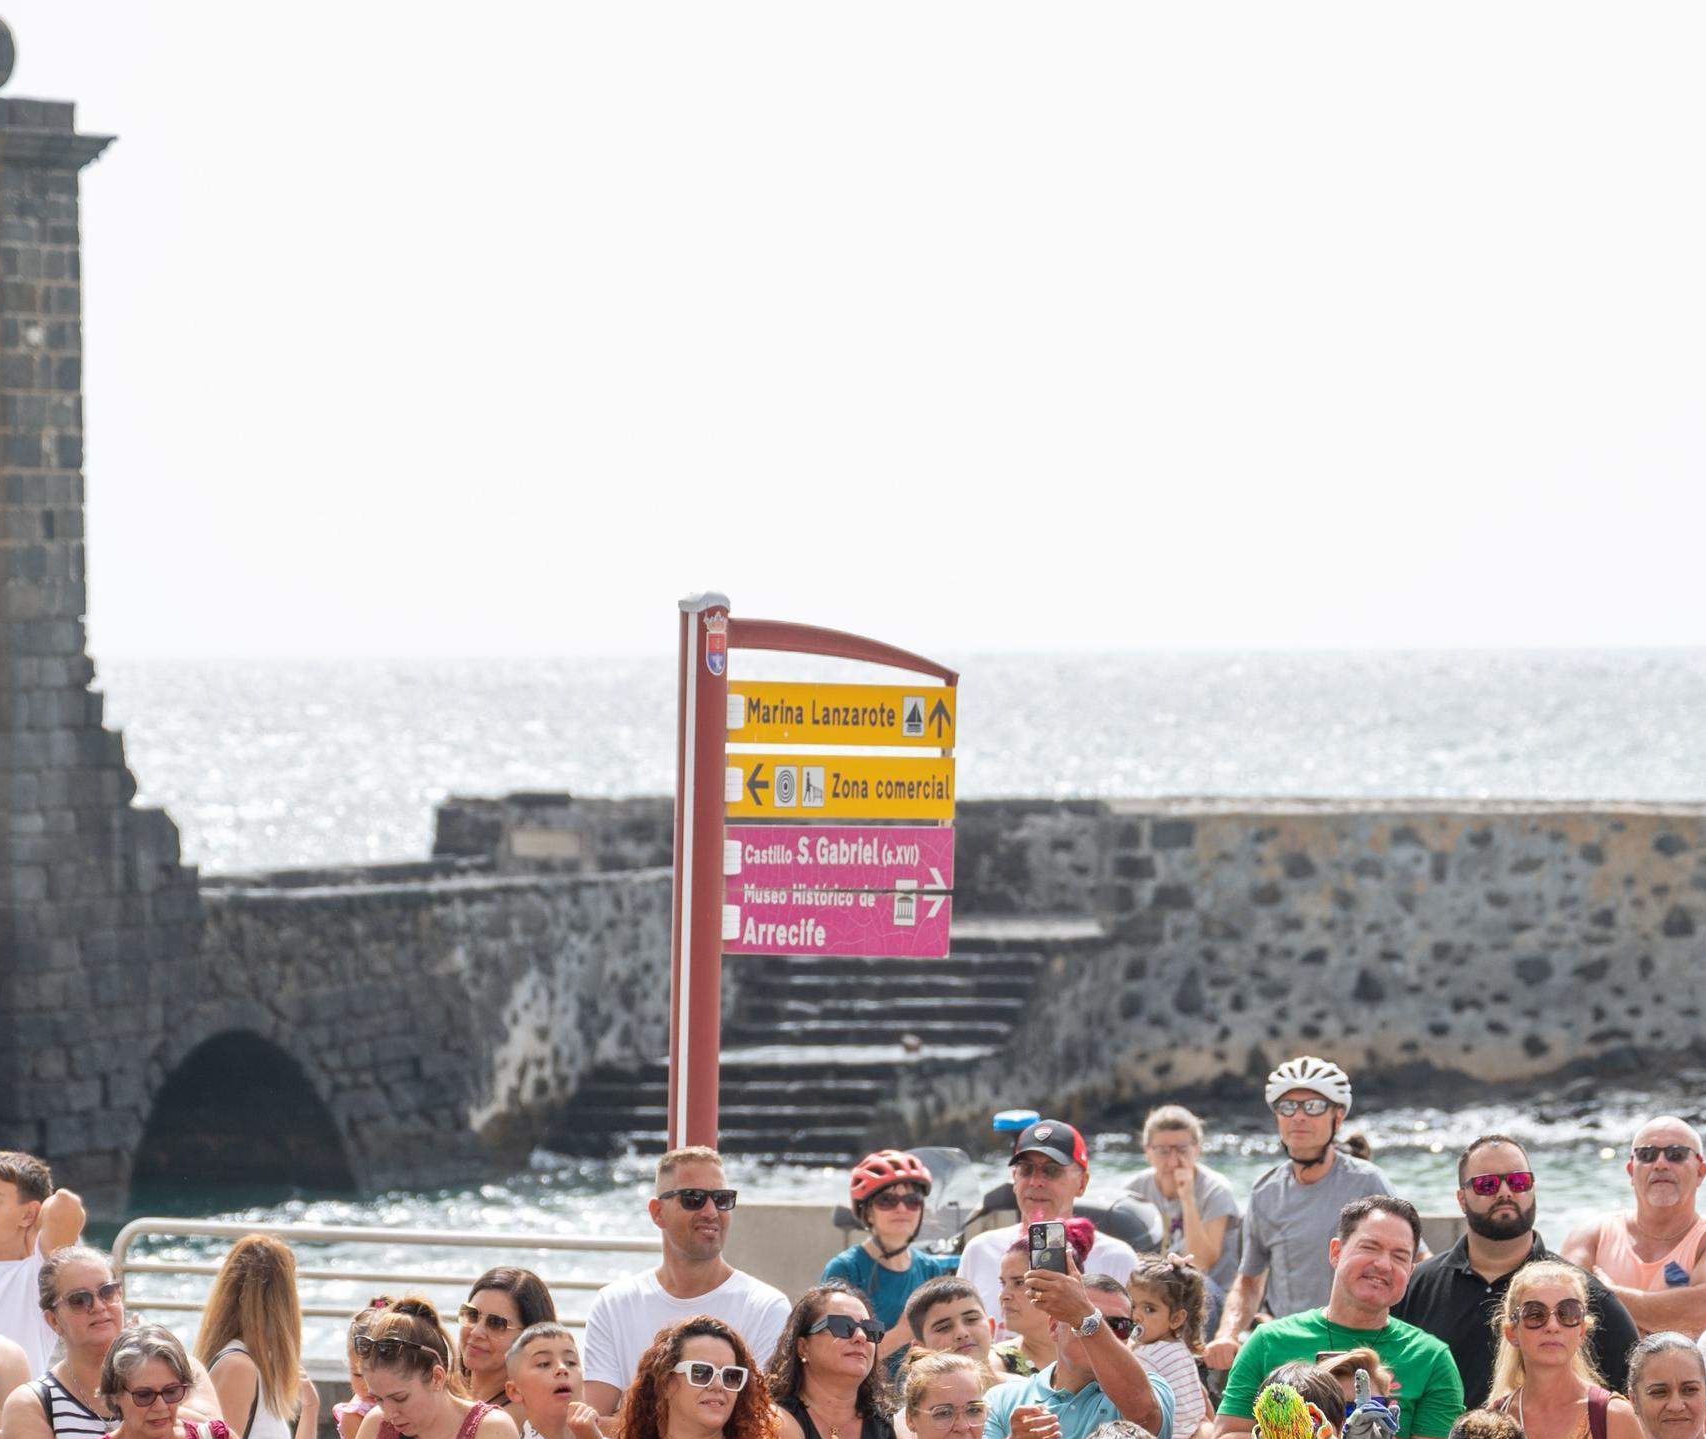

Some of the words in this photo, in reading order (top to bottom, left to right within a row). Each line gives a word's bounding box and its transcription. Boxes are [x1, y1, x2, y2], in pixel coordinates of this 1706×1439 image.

[747, 698, 804, 725] Marina
[812, 700, 896, 727] Lanzarote
[832, 773, 869, 799] Zona
[876, 774, 950, 800] comercial
[744, 844, 793, 865] Castillo
[797, 836, 813, 866] S.
[816, 836, 879, 865] Gabriel
[743, 884, 787, 905] Museo
[792, 883, 853, 907] Histórico
[859, 885, 876, 908] de
[743, 917, 826, 947] Arrecife
